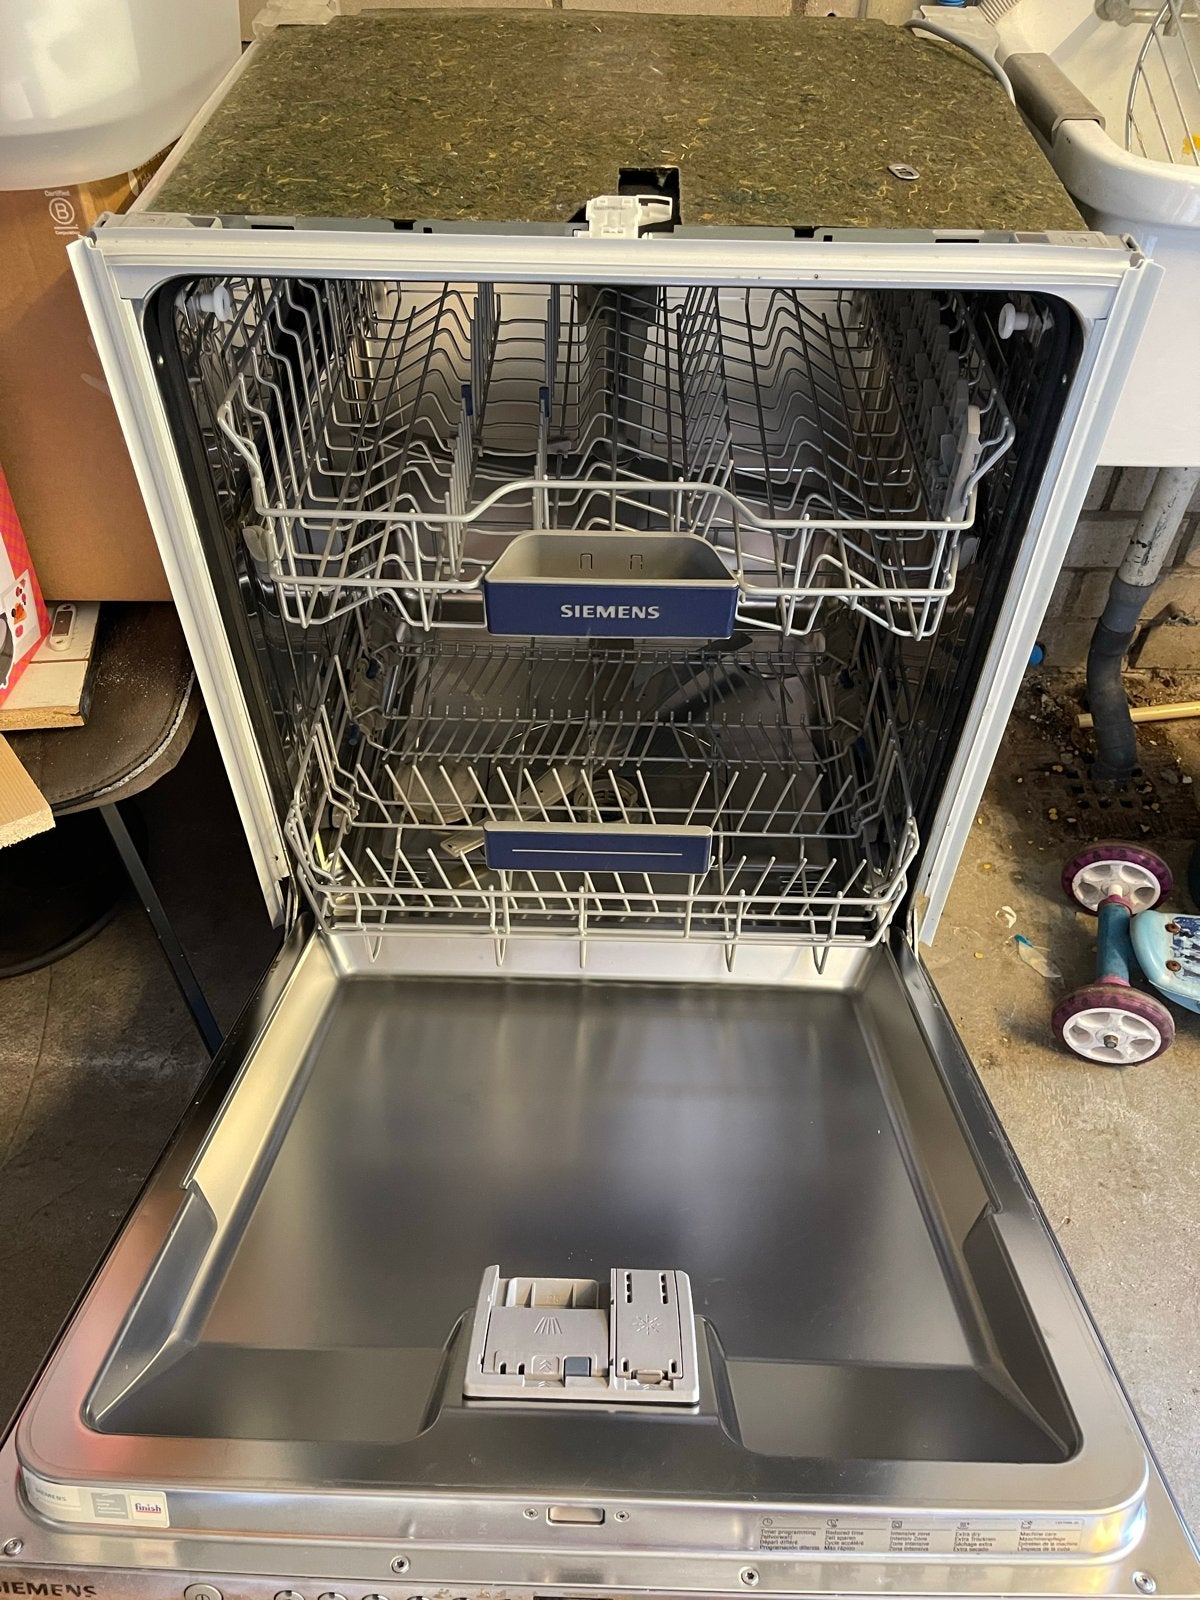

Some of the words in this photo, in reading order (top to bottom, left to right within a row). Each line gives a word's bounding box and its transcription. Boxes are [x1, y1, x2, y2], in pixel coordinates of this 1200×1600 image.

[560, 604, 660, 619] SIEMENS
[134, 1502, 162, 1512] finish
[0, 1581, 97, 1597] IEMENS
